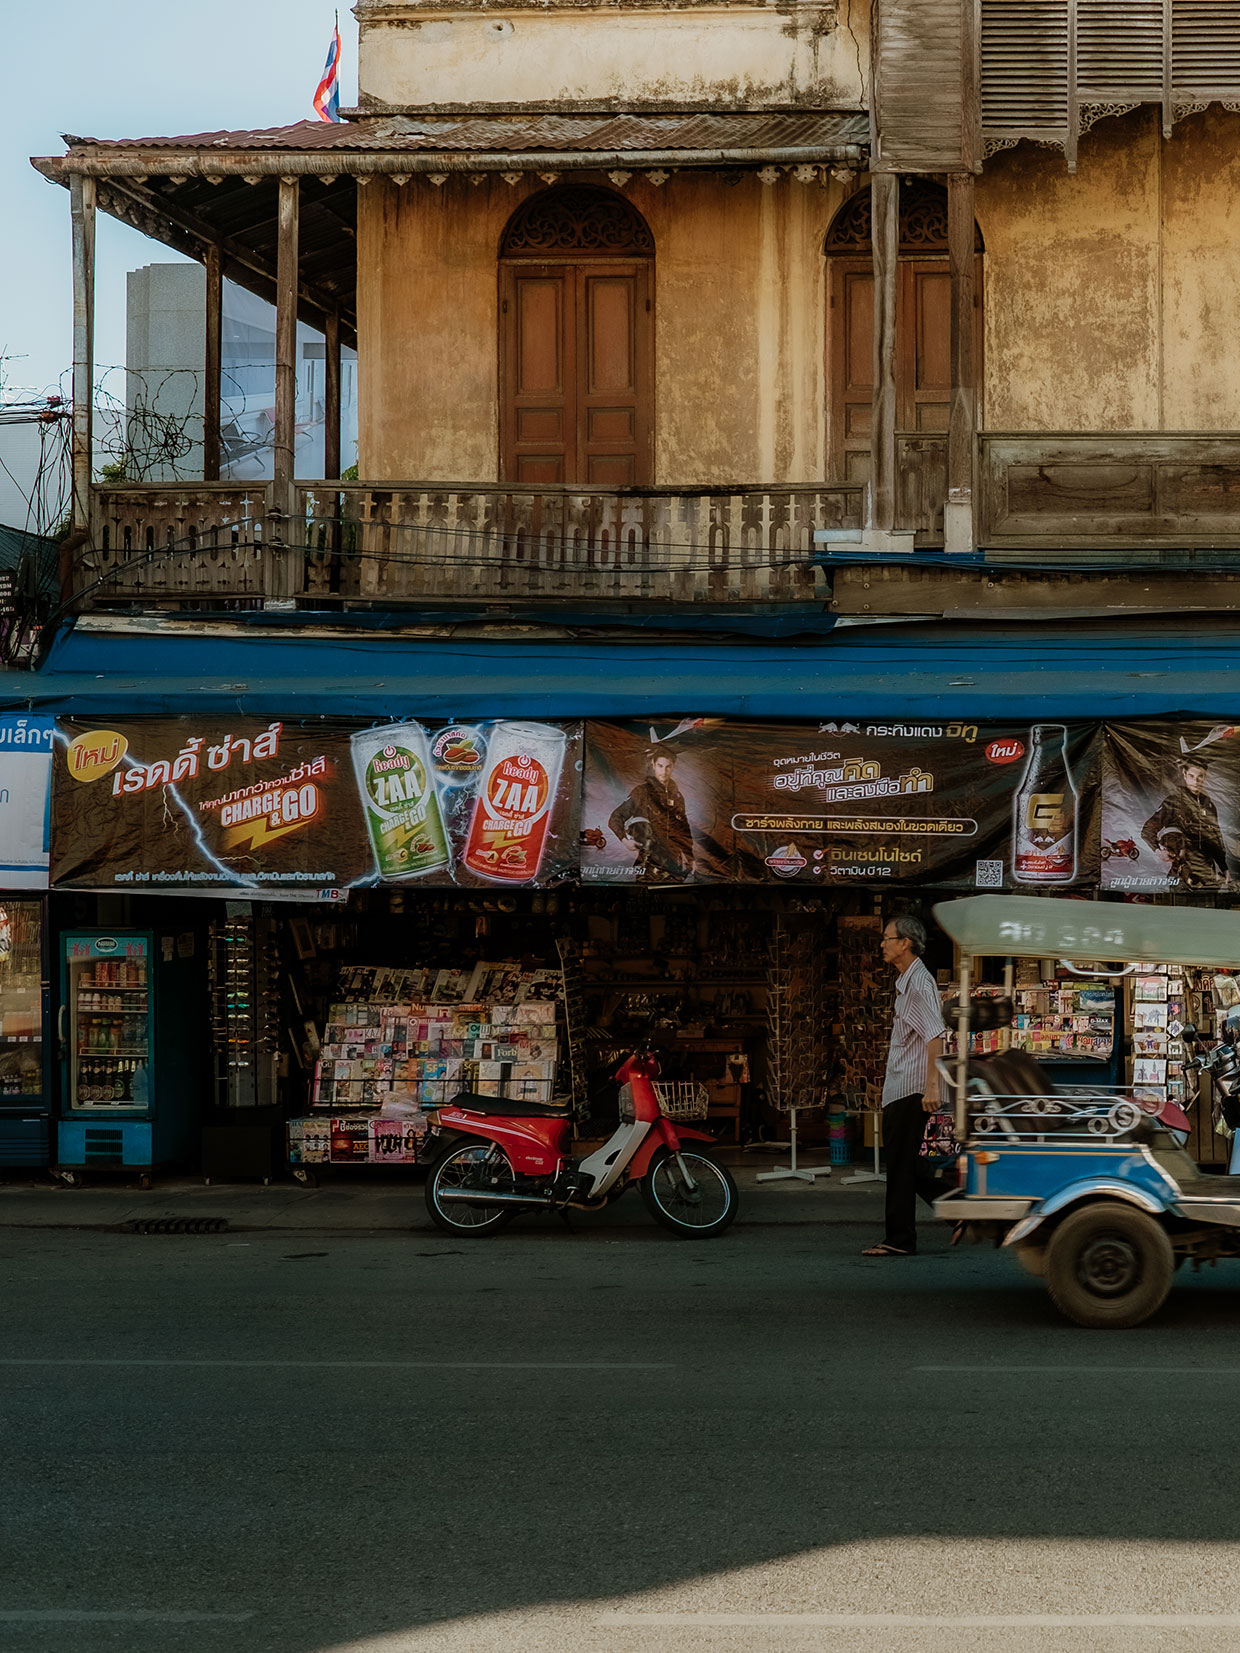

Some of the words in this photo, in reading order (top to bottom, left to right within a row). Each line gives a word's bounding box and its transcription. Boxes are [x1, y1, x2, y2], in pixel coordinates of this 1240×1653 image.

[866, 724, 943, 738] กระทิงแดง
[73, 738, 118, 770] ใหม่
[112, 737, 204, 796] เรดดี้
[207, 722, 282, 771] ซ่าส์
[990, 742, 1017, 758] ใหม่
[373, 754, 410, 773] Ready
[503, 761, 539, 784] Ready
[374, 770, 422, 806] ZAA
[492, 779, 539, 813] ZAA
[221, 790, 281, 826] CHARGE
[271, 812, 281, 826] &
[282, 784, 317, 822] GO
[380, 813, 410, 834] CHARGE
[409, 804, 426, 825] GO
[483, 819, 514, 831] CHARGE
[513, 820, 533, 836] GO
[877, 867, 891, 876] 12
[316, 889, 338, 899] TMB
[497, 1048, 517, 1056] Forb
